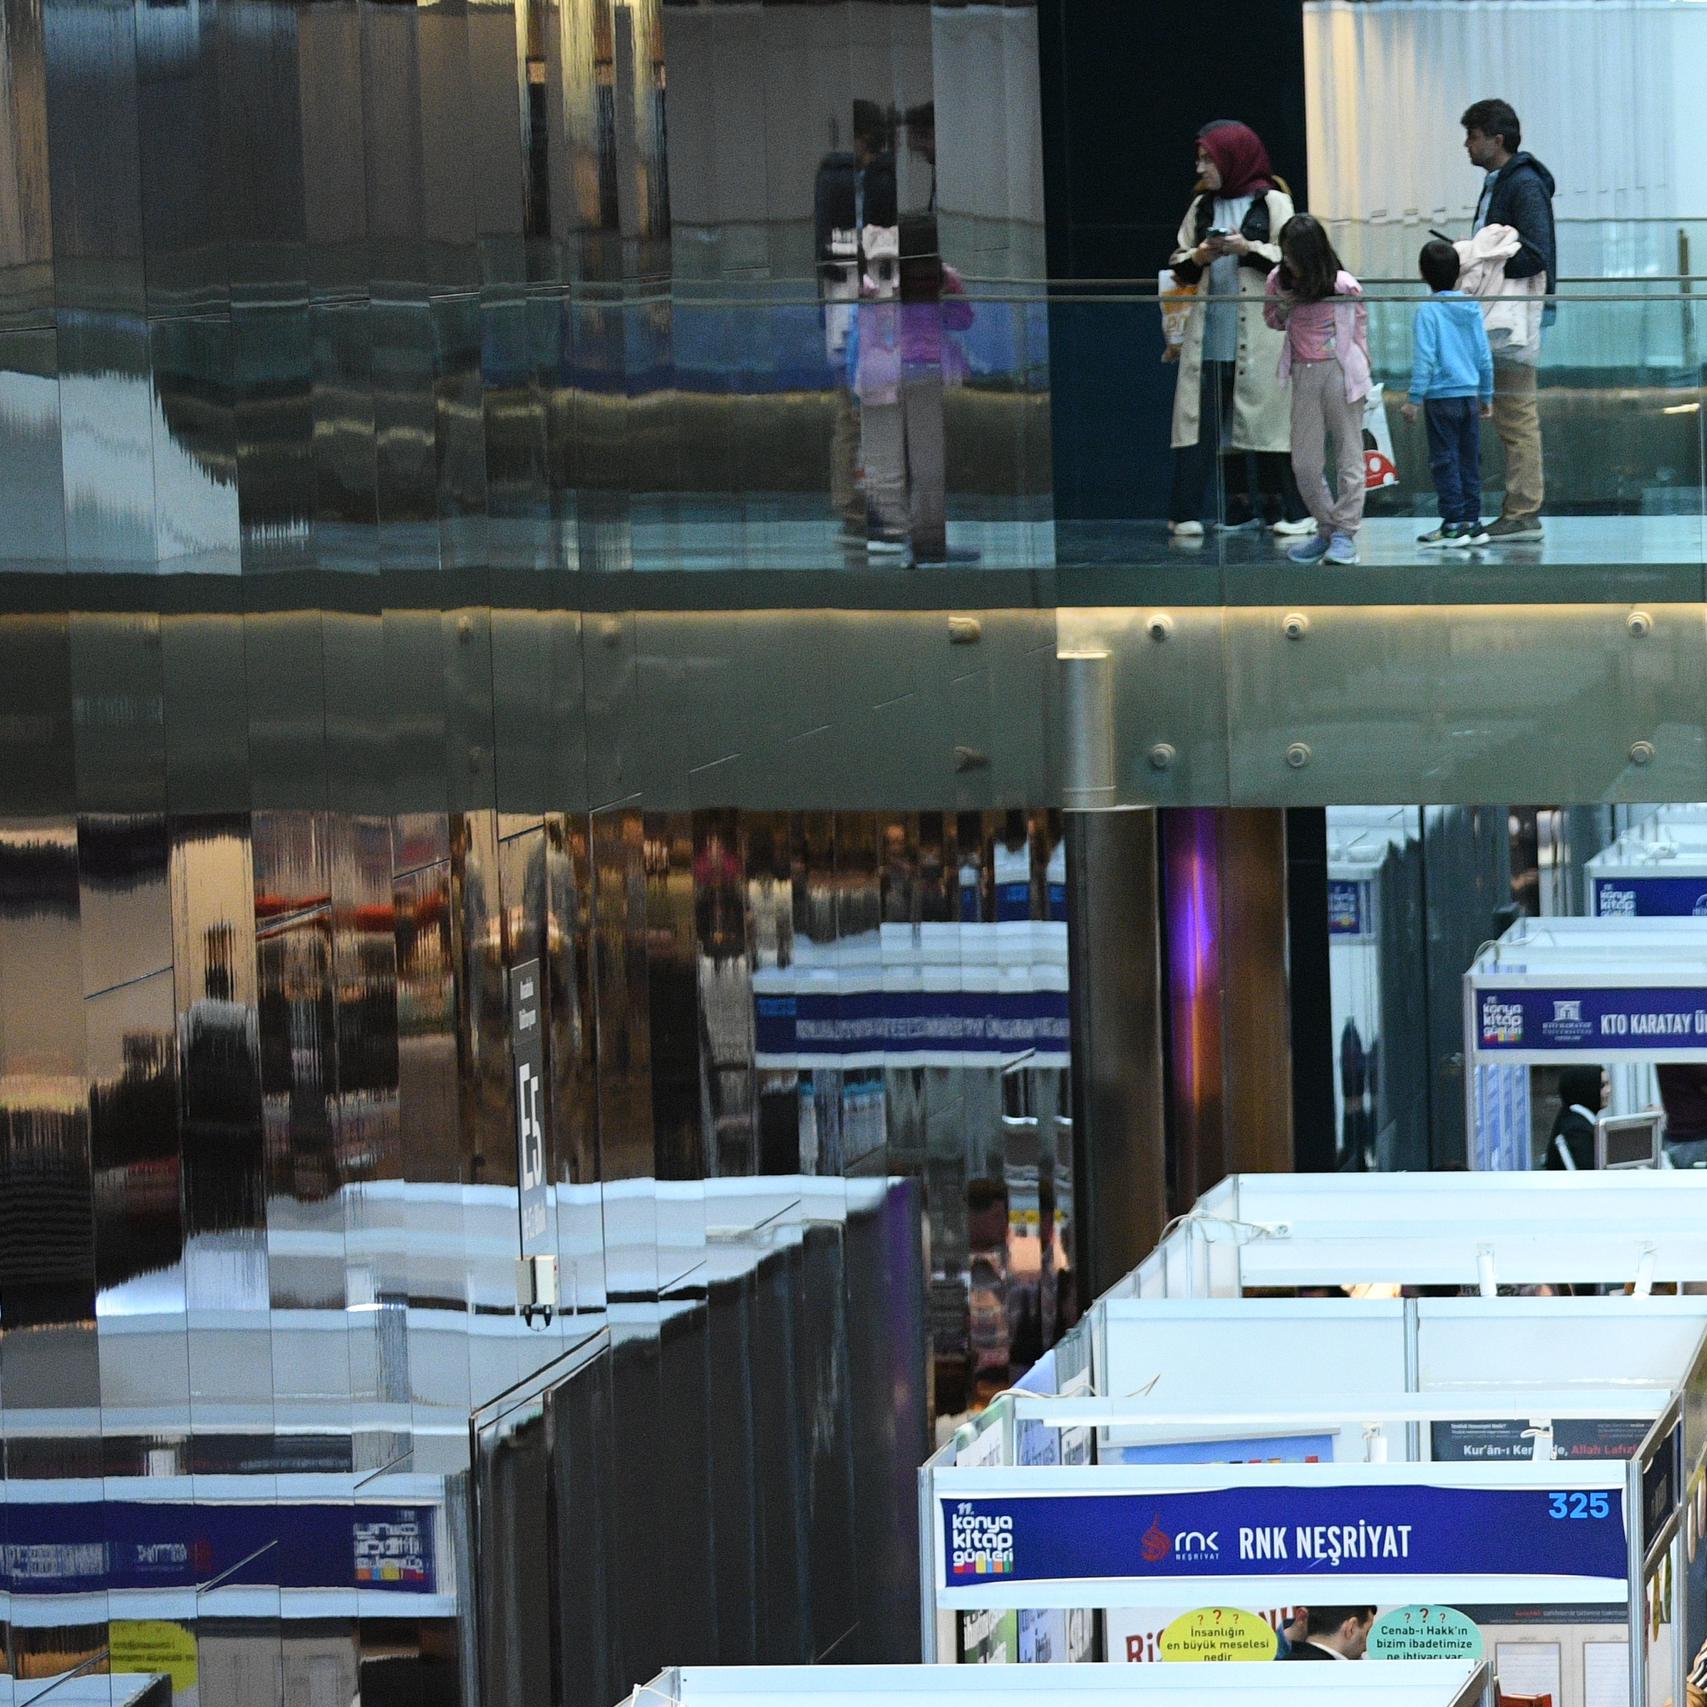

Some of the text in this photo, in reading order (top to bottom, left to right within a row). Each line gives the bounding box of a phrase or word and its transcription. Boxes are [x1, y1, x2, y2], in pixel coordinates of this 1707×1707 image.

[1600, 1014, 1627, 1035] KTO
[1630, 1013, 1693, 1035] KARATAY
[519, 1062, 542, 1192] E5
[957, 1502, 974, 1516] 11.
[1548, 1492, 1609, 1519] 325
[952, 1514, 1013, 1533] konya
[952, 1529, 1013, 1549] kitap
[1239, 1519, 1412, 1566] RNK NEŞRİYAT
[953, 1549, 1013, 1566] günleri
[1190, 1626, 1245, 1639] İnsanlığın
[1381, 1625, 1468, 1637] Cenab-ı Hakk'ın
[1166, 1638, 1270, 1651] en büyük meselesi
[1376, 1638, 1473, 1649] bizim ibadetimize
[1203, 1651, 1233, 1661] nedir
